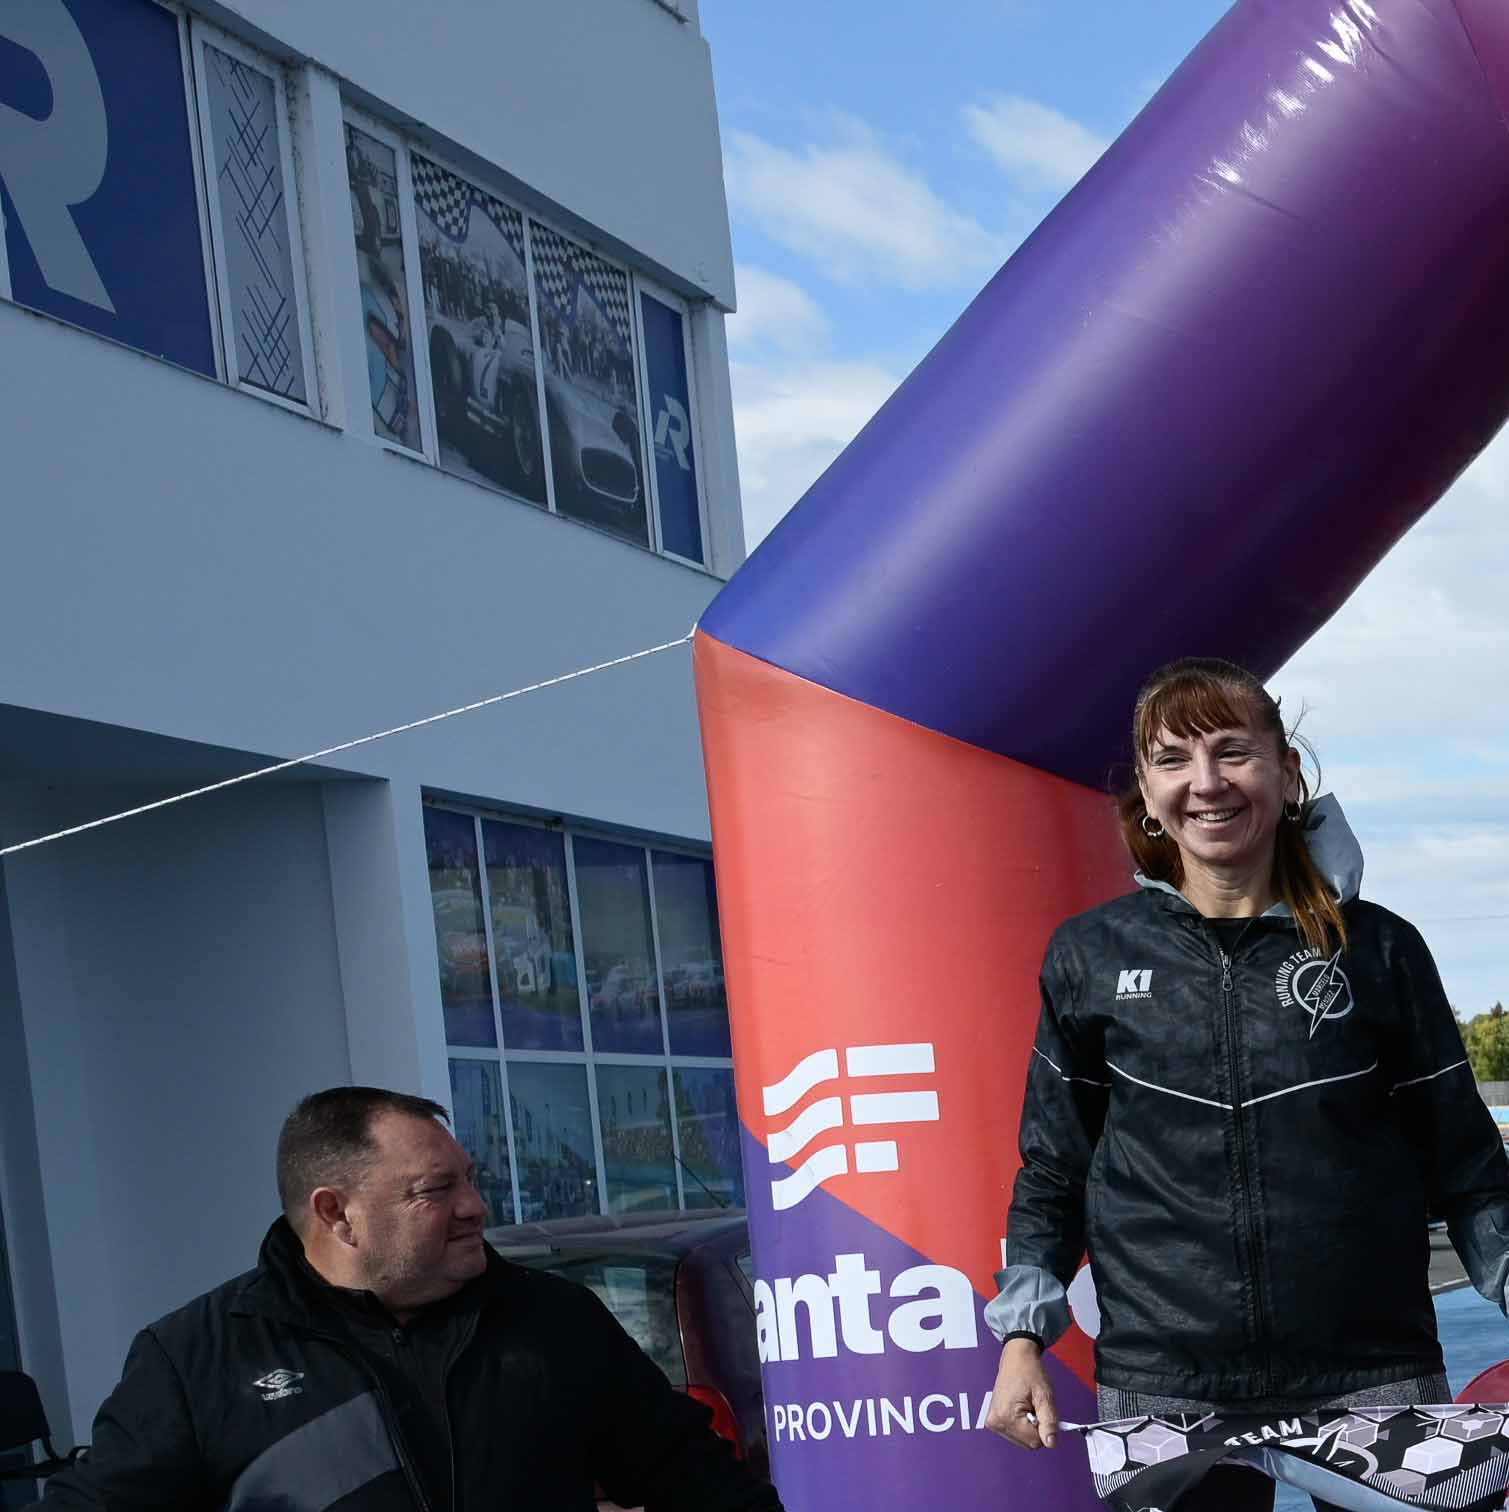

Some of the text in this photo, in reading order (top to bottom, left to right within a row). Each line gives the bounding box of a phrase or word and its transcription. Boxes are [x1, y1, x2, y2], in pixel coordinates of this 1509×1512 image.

[1117, 969, 1152, 993] K1
[1275, 946, 1321, 1008] RUNNING TEAM
[1115, 991, 1152, 1000] RUNNING
[754, 1253, 978, 1363] anta
[1224, 1417, 1303, 1447] TEAM
